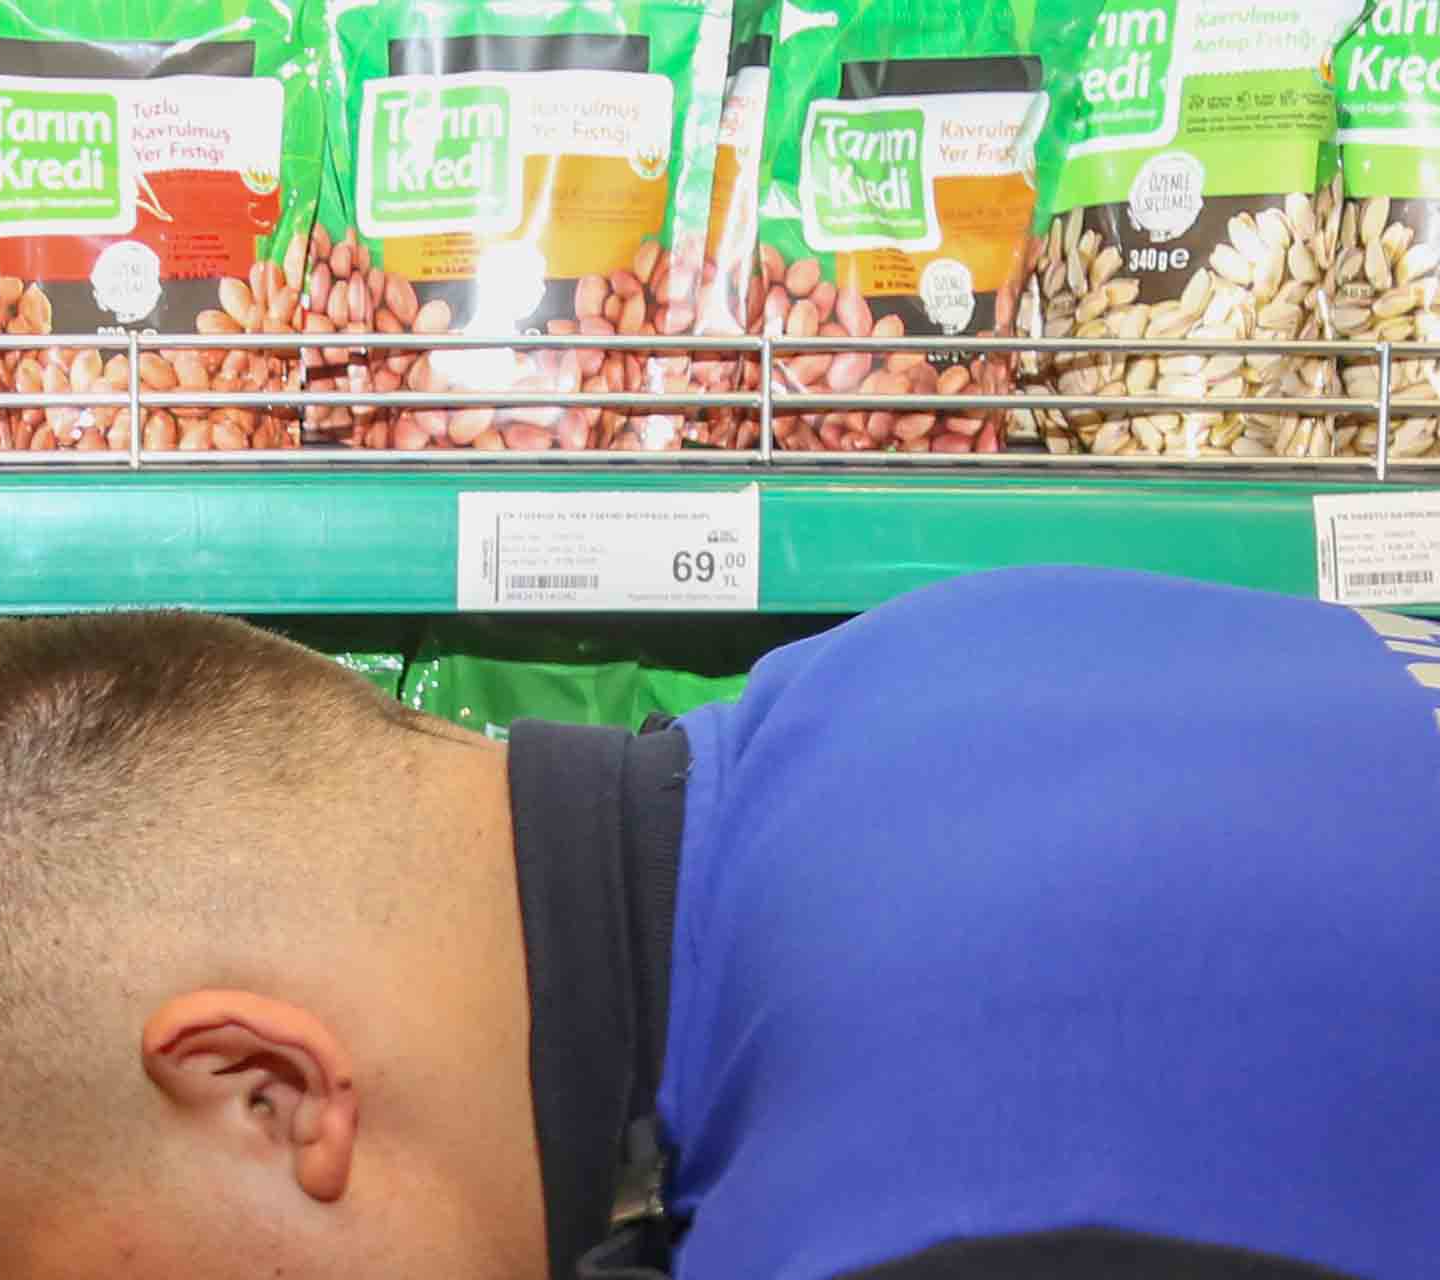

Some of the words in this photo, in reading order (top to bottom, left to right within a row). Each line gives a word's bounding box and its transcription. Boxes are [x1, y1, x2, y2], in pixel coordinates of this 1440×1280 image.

[131, 99, 180, 119] Tuzlu
[132, 121, 233, 148] Kavrulmuş
[820, 116, 917, 161] Tarım
[131, 146, 162, 163] Yer
[386, 148, 493, 193] Kredi
